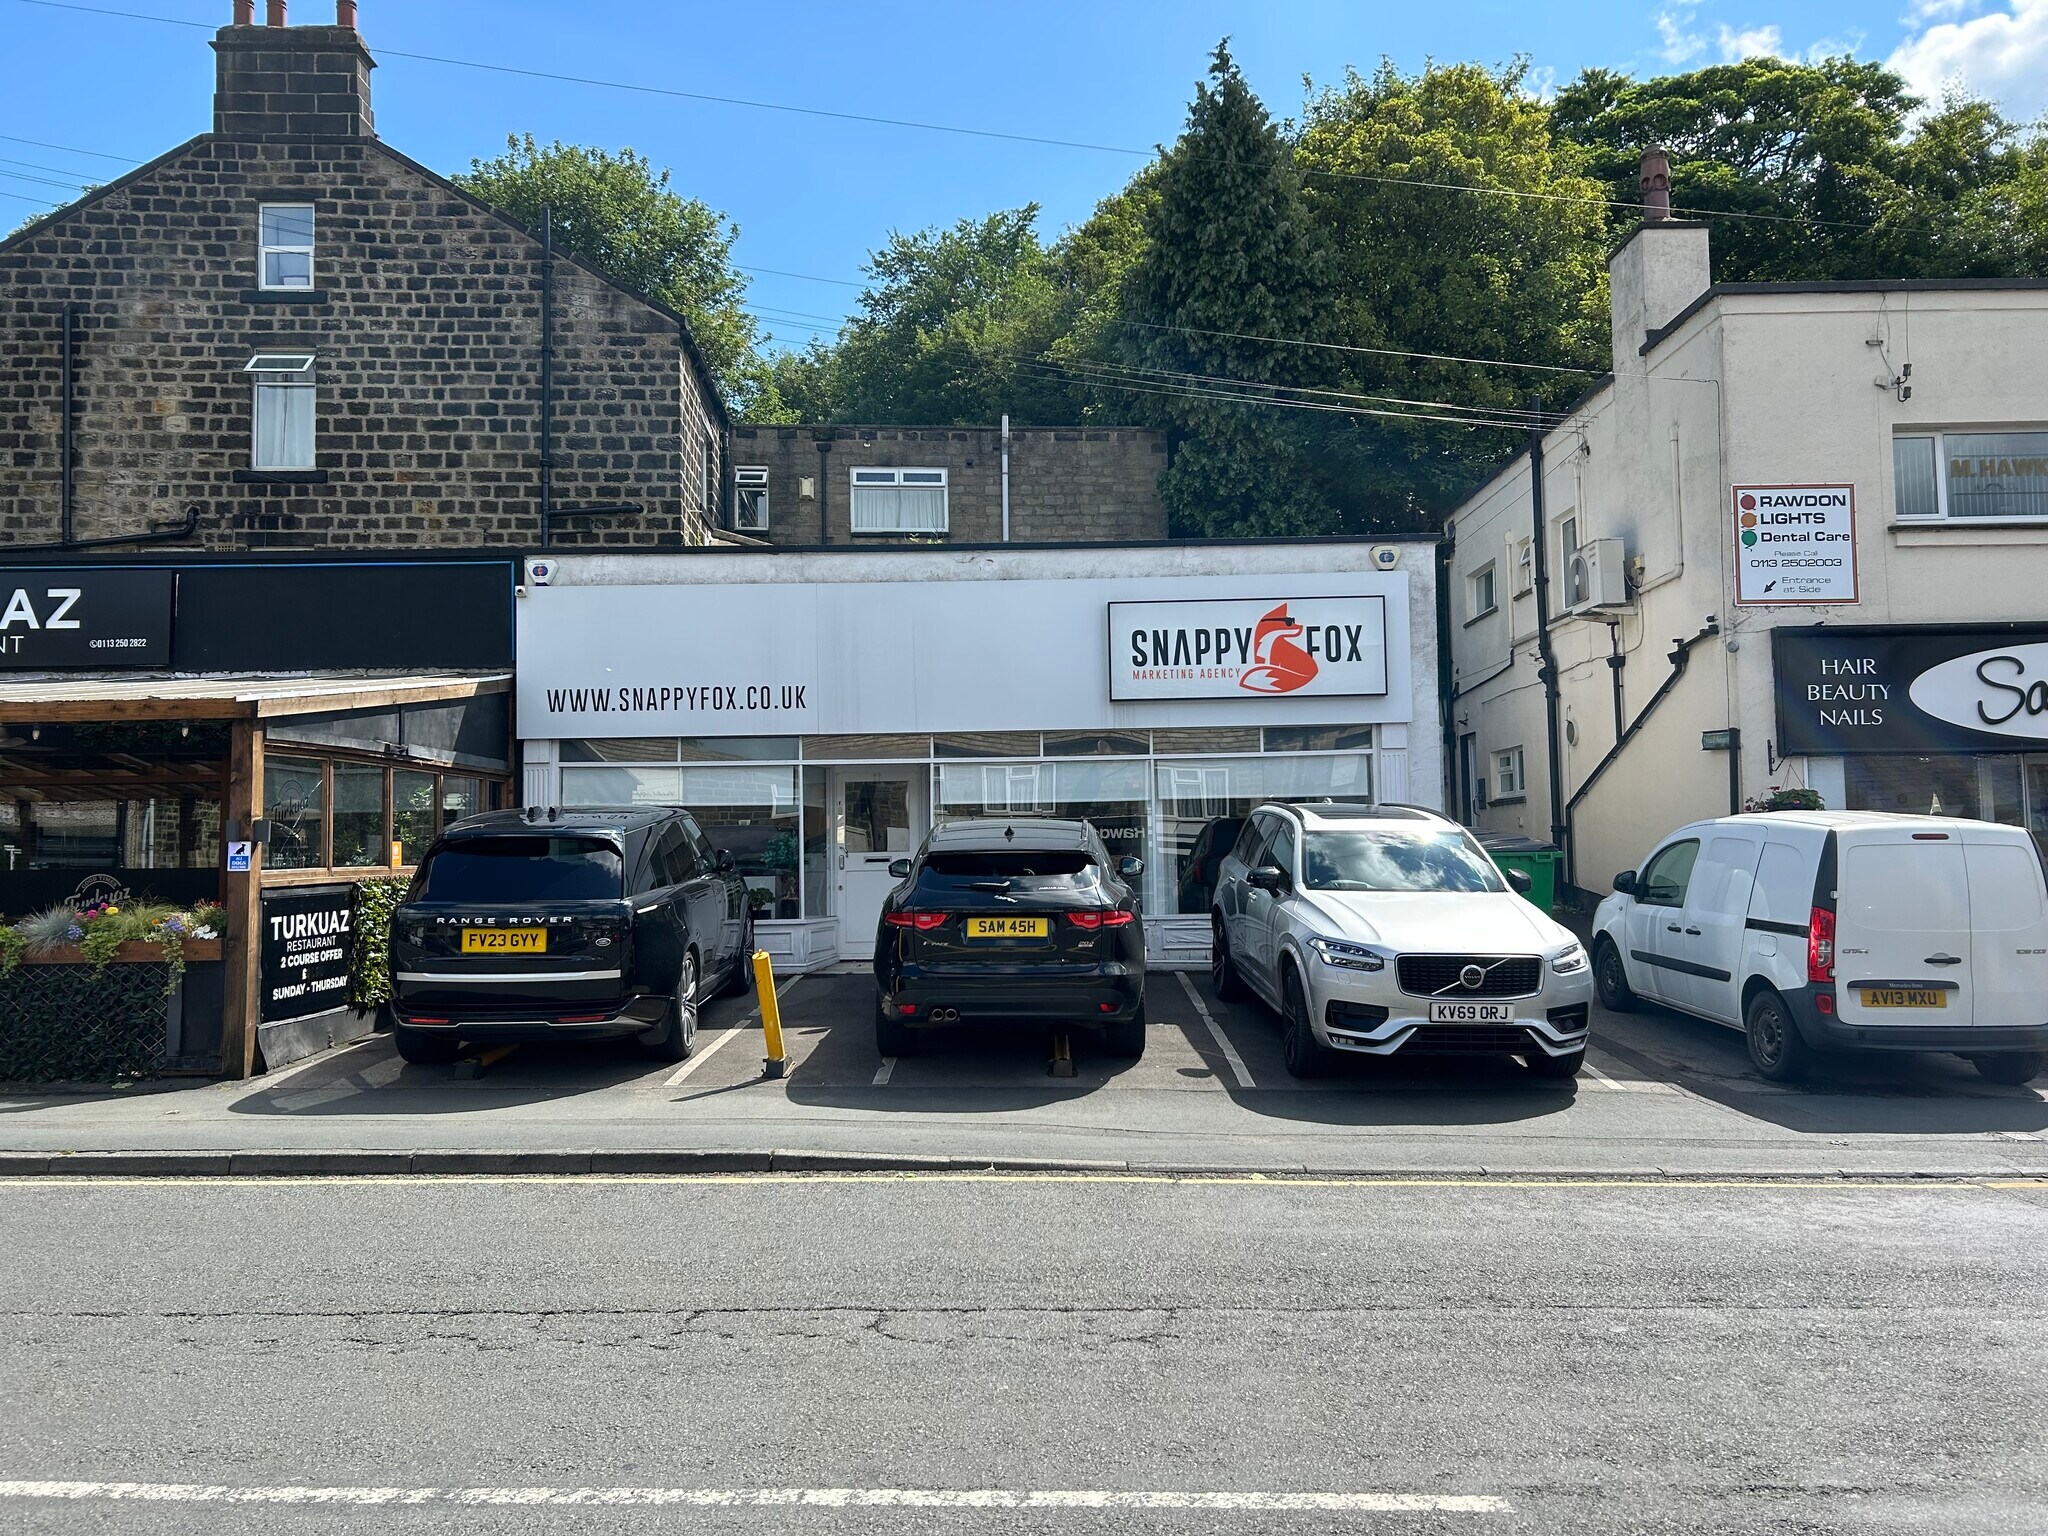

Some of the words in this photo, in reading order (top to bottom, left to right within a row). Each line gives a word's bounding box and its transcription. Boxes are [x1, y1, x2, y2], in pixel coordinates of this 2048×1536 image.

[1759, 494, 1847, 507] RAWDON
[1760, 512, 1826, 525] LIGHTS
[1760, 531, 1810, 543] Dental
[1815, 531, 1851, 542] Care
[1750, 559, 1777, 568] 0113
[1781, 558, 1842, 567] 2502003
[1781, 576, 1831, 584] Entrance
[1798, 585, 1821, 593] Side
[97, 639, 115, 648] 0113
[115, 639, 129, 648] 250
[129, 638, 147, 647] 2822
[1131, 627, 1252, 667] SNAPPY
[1305, 625, 1363, 663] FOX
[1132, 669, 1194, 680] MARKETING
[1200, 667, 1241, 679] AGENCY
[1822, 658, 1877, 675] HAIR
[546, 685, 807, 713] WWW.SNAPPYFOX.CO.UK
[1807, 684, 1891, 701] BEAUTY
[1820, 709, 1883, 726] NAILS
[81, 876, 98, 889] GOOD
[98, 875, 117, 887] TIMES
[270, 909, 350, 941] TURKUAZ
[436, 917, 496, 925] RANGE
[509, 915, 573, 924] ROVER
[978, 920, 1006, 933] SAM
[1008, 920, 1036, 933] 45H
[286, 935, 337, 953] RESTAURANT
[469, 933, 507, 948] FV23
[510, 932, 540, 947] GYY
[280, 956, 287, 969] 2
[287, 951, 320, 968] COURSE
[320, 948, 343, 962] OFFER
[272, 983, 306, 1001] SUNDAY
[310, 975, 348, 993] THURSDAY
[1871, 991, 1905, 1005] AV13
[1907, 991, 1937, 1005] MXU
[1437, 1006, 1476, 1019] KV69
[1480, 1006, 1508, 1019] ORJ
